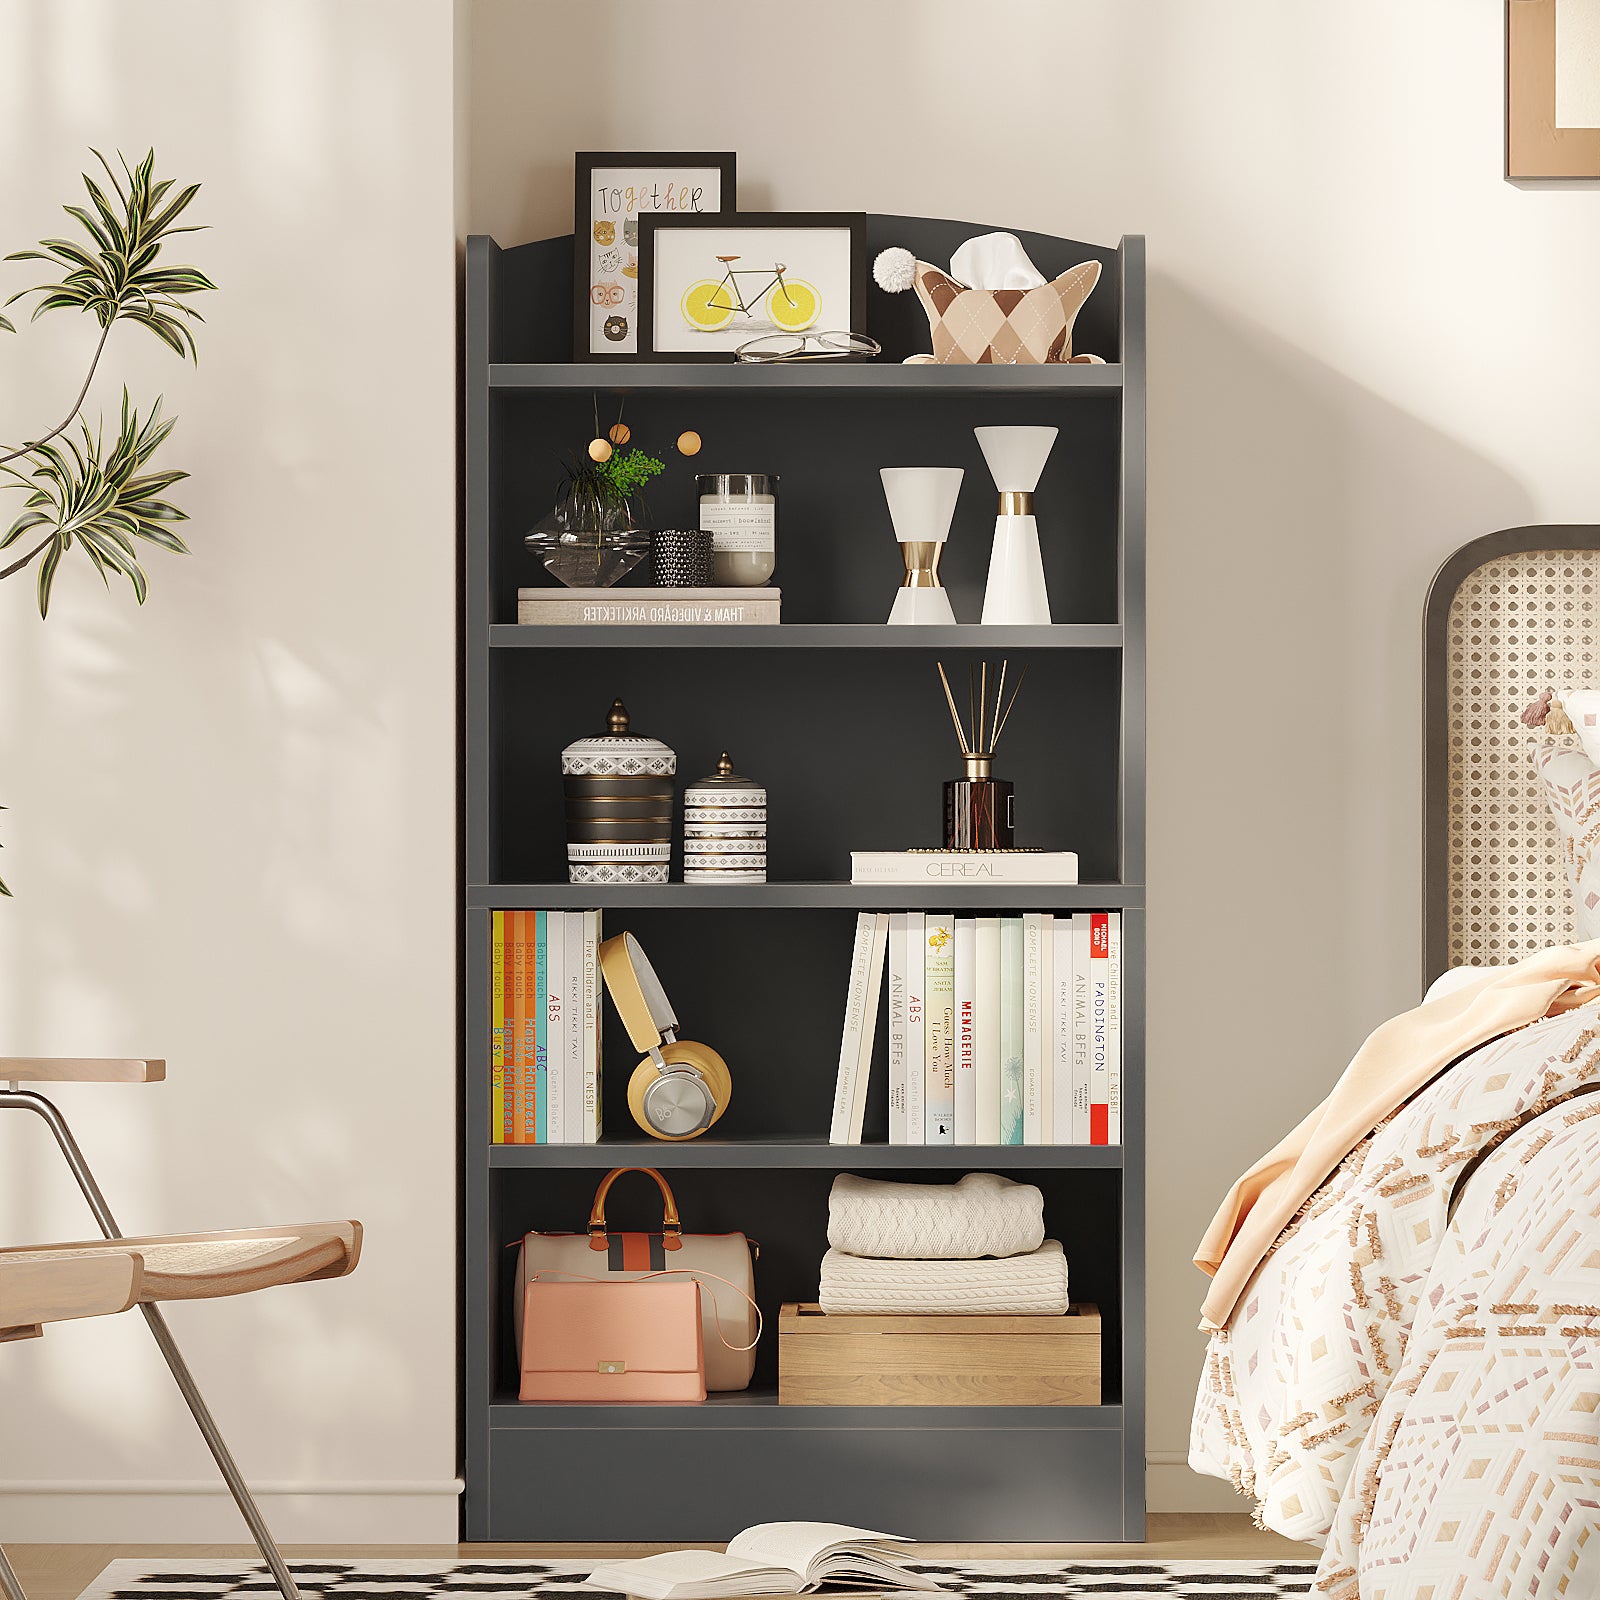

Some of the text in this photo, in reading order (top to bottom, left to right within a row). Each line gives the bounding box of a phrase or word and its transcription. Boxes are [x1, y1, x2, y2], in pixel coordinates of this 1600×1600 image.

[926, 862, 1004, 877] CEREAL
[586, 940, 594, 958] Five
[1110, 941, 1118, 959] Five
[494, 942, 503, 999] Baby touch
[515, 942, 524, 999] Baby touch
[526, 942, 535, 999] Baby touch
[536, 942, 545, 999] Baby touch
[586, 961, 594, 999] Children
[851, 924, 870, 1032] COMPLETE NONSENSE
[1029, 924, 1037, 1033] COMPLETE NONSENSE
[1110, 962, 1118, 1000] Children
[549, 994, 560, 1022] ABS
[586, 1002, 594, 1019] and
[909, 995, 921, 1023] ABS
[1110, 1003, 1118, 1019] and
[932, 1029, 941, 1051] Love
[962, 1001, 972, 1069] MENAGERIE
[1094, 982, 1105, 1072] PADDINGTON
[493, 1027, 504, 1089] Busy Day
[536, 1045, 547, 1071] ABC
[932, 1055, 941, 1073] You
[944, 1007, 953, 1089] Guess How Much
[504, 1018, 514, 1134] Happy Halloween
[525, 1018, 536, 1134] Happy Halloween
[551, 1069, 559, 1101] Quentin
[842, 1067, 850, 1095] EDWARD
[586, 1082, 594, 1113] NESBIT
[1110, 1083, 1118, 1115] NESBIT
